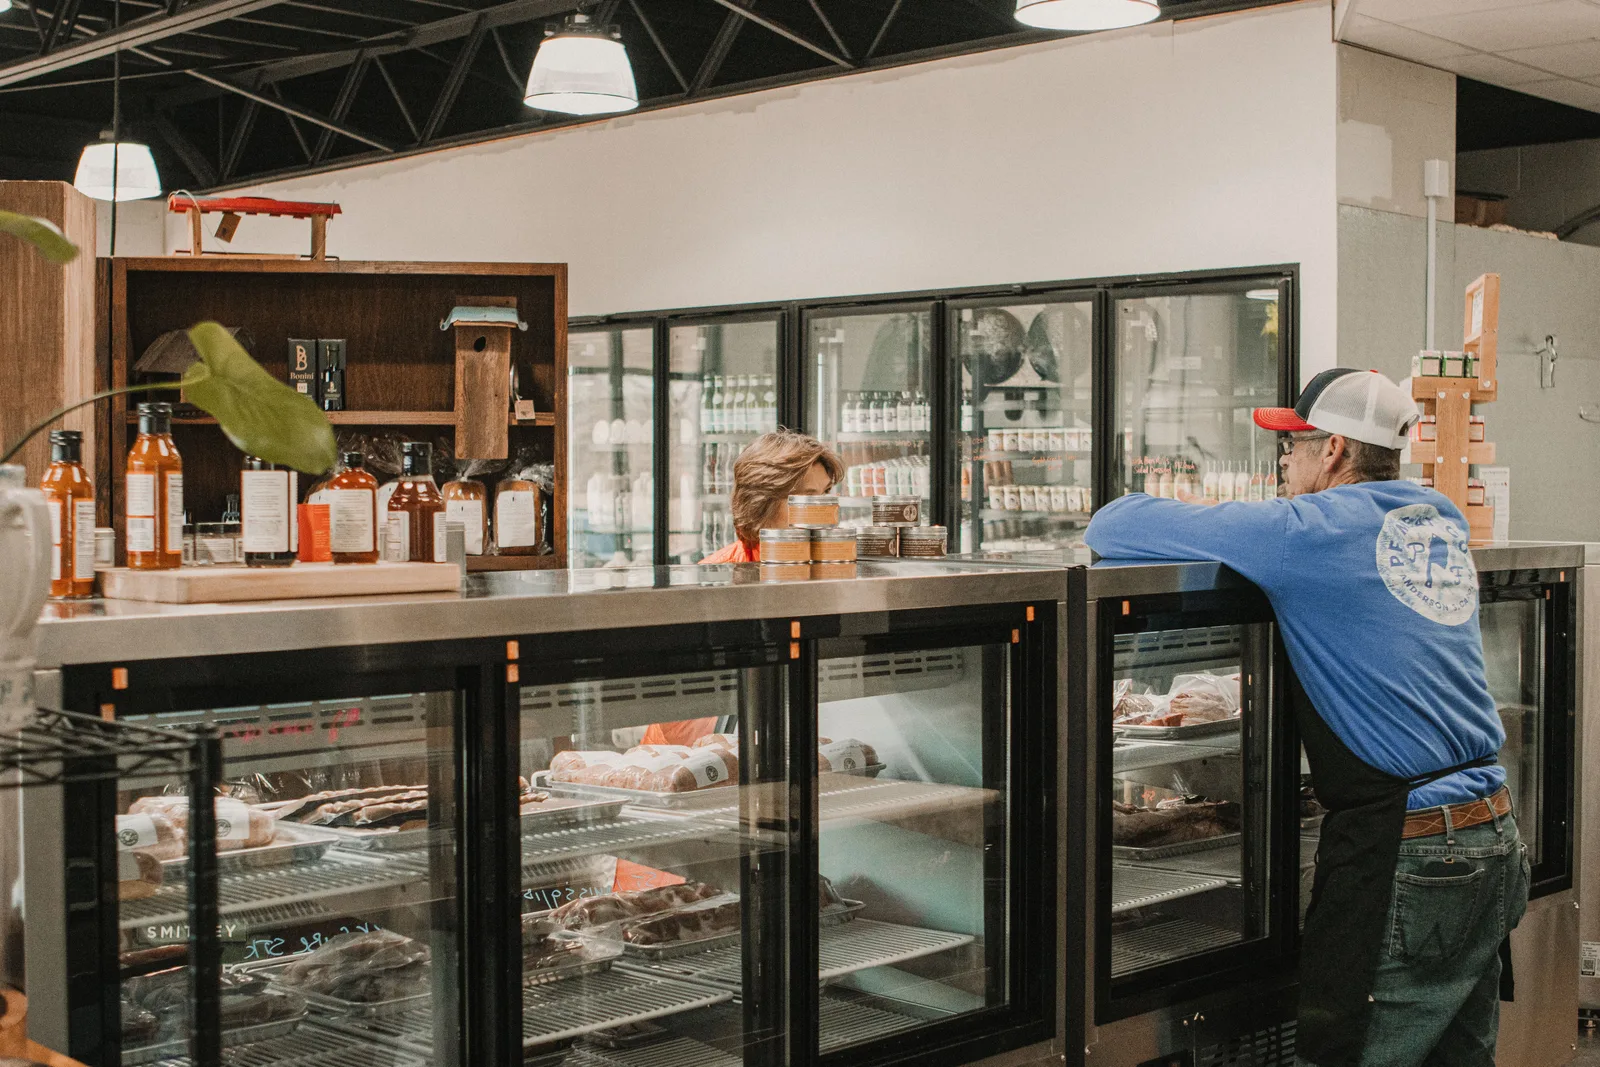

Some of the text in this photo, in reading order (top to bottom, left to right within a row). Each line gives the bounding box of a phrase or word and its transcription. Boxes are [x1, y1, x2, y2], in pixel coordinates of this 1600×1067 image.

[290, 372, 314, 380] Bonini
[1400, 573, 1449, 612] ANDERSON
[147, 924, 237, 938] SMITEY
